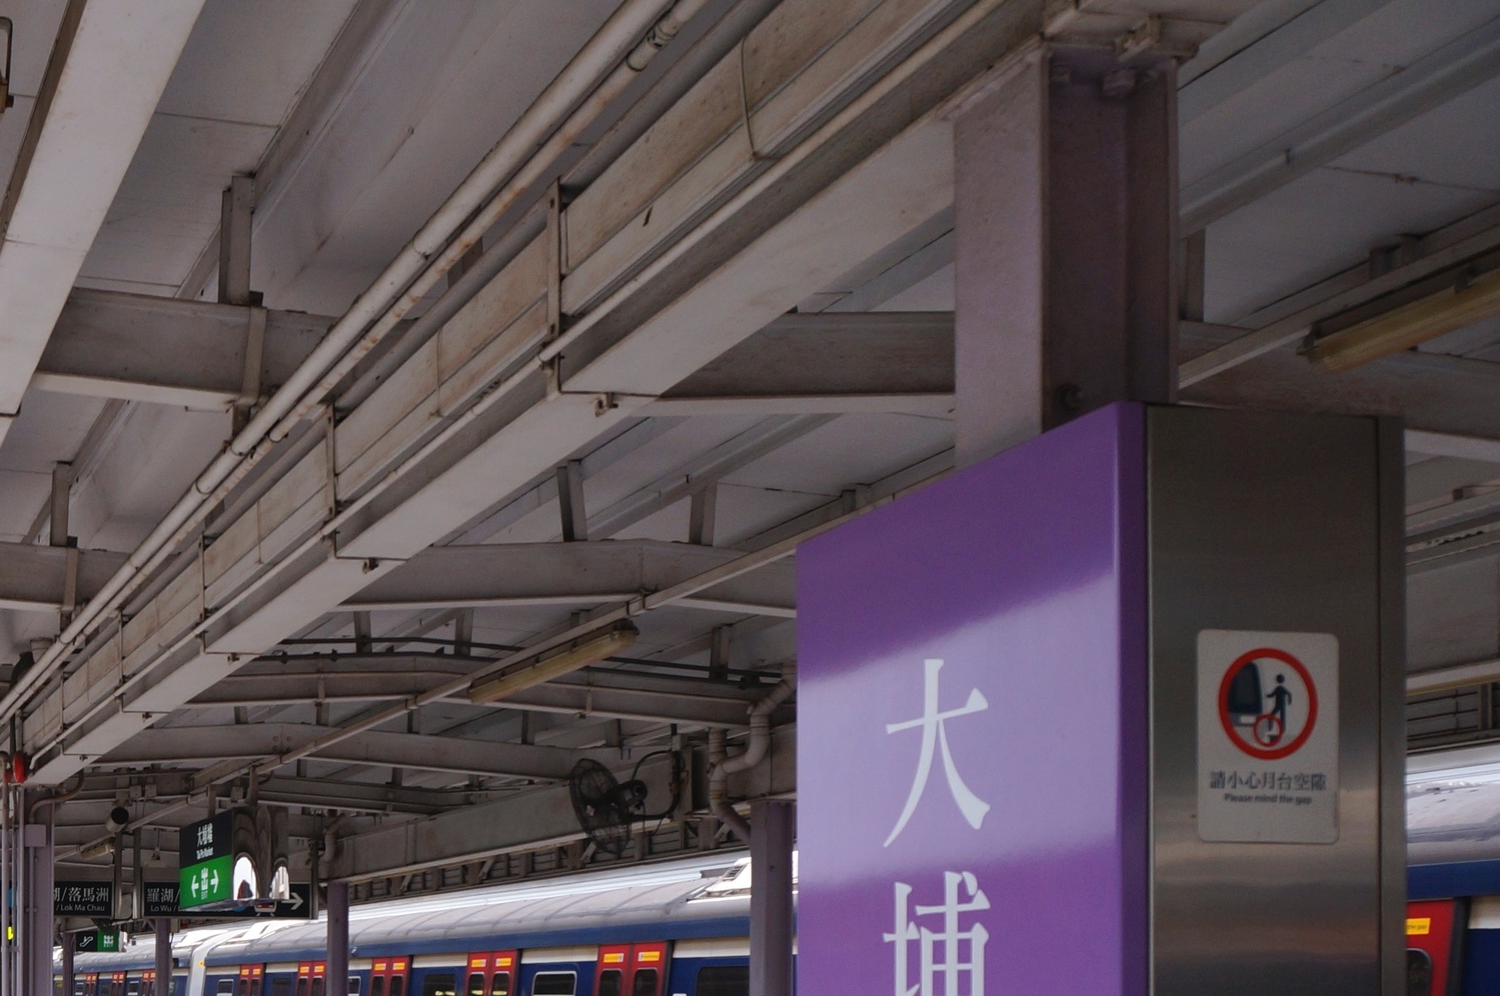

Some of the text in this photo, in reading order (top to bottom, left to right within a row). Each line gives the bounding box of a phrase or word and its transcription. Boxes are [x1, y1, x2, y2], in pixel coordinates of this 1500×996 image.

[1209, 770, 1327, 792] 請小心月台空隙
[1224, 792, 1312, 806] Please mind the gap
